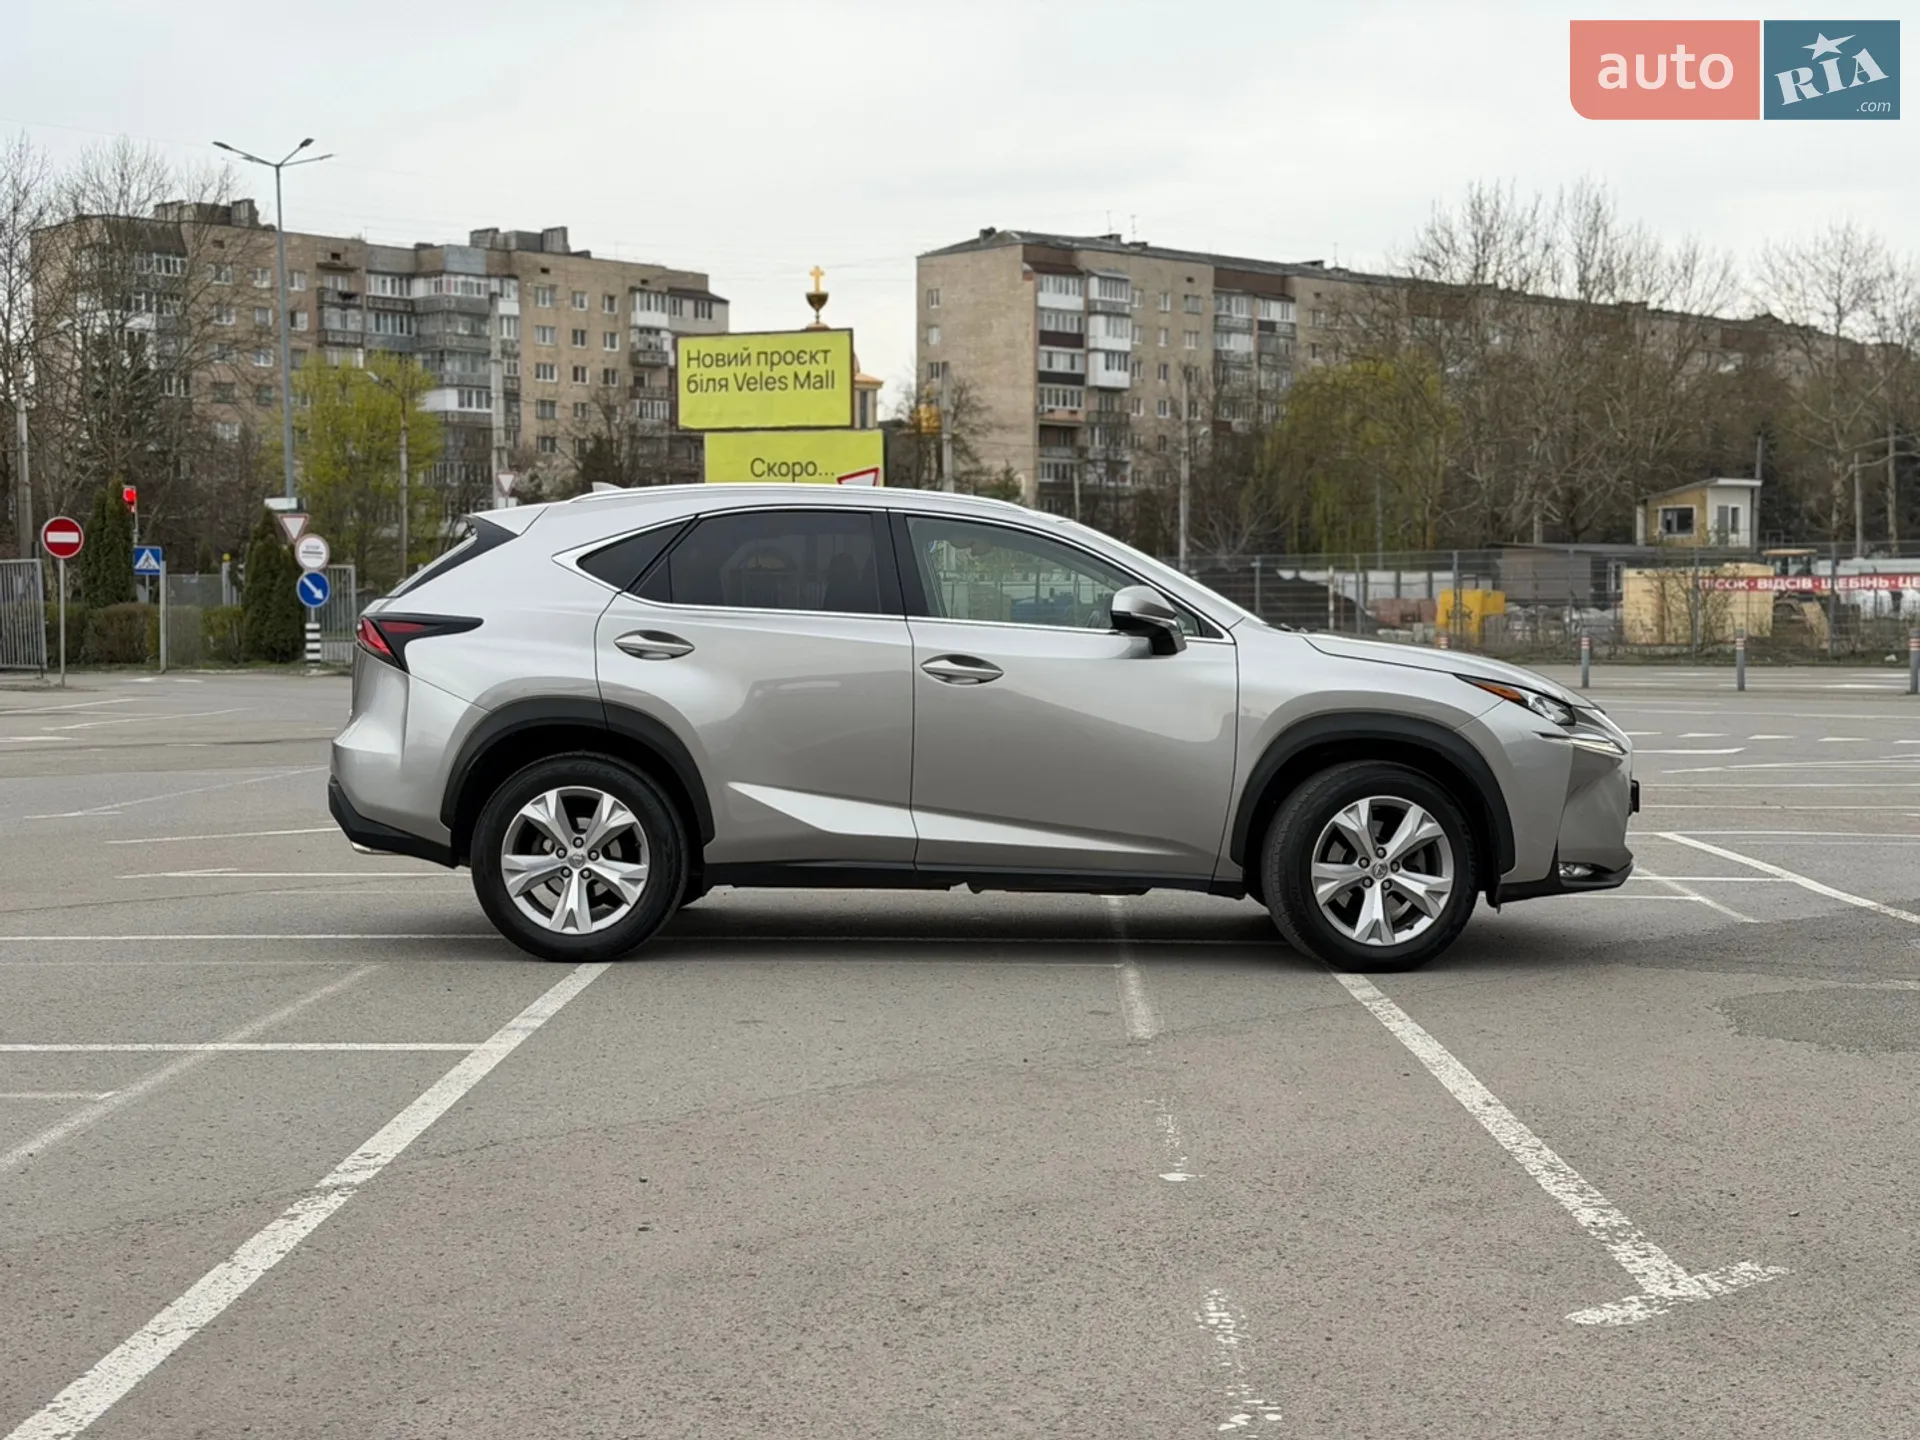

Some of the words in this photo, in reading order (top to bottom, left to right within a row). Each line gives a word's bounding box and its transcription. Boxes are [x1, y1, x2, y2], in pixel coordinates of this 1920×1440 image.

[686, 346, 752, 369] Новий
[756, 347, 832, 372] проєкт
[686, 373, 729, 394] біля
[733, 372, 789, 392] Veles
[793, 370, 836, 391] Mall
[750, 457, 835, 482] Скоро...
[1757, 578, 1813, 590] ВІДСІВ
